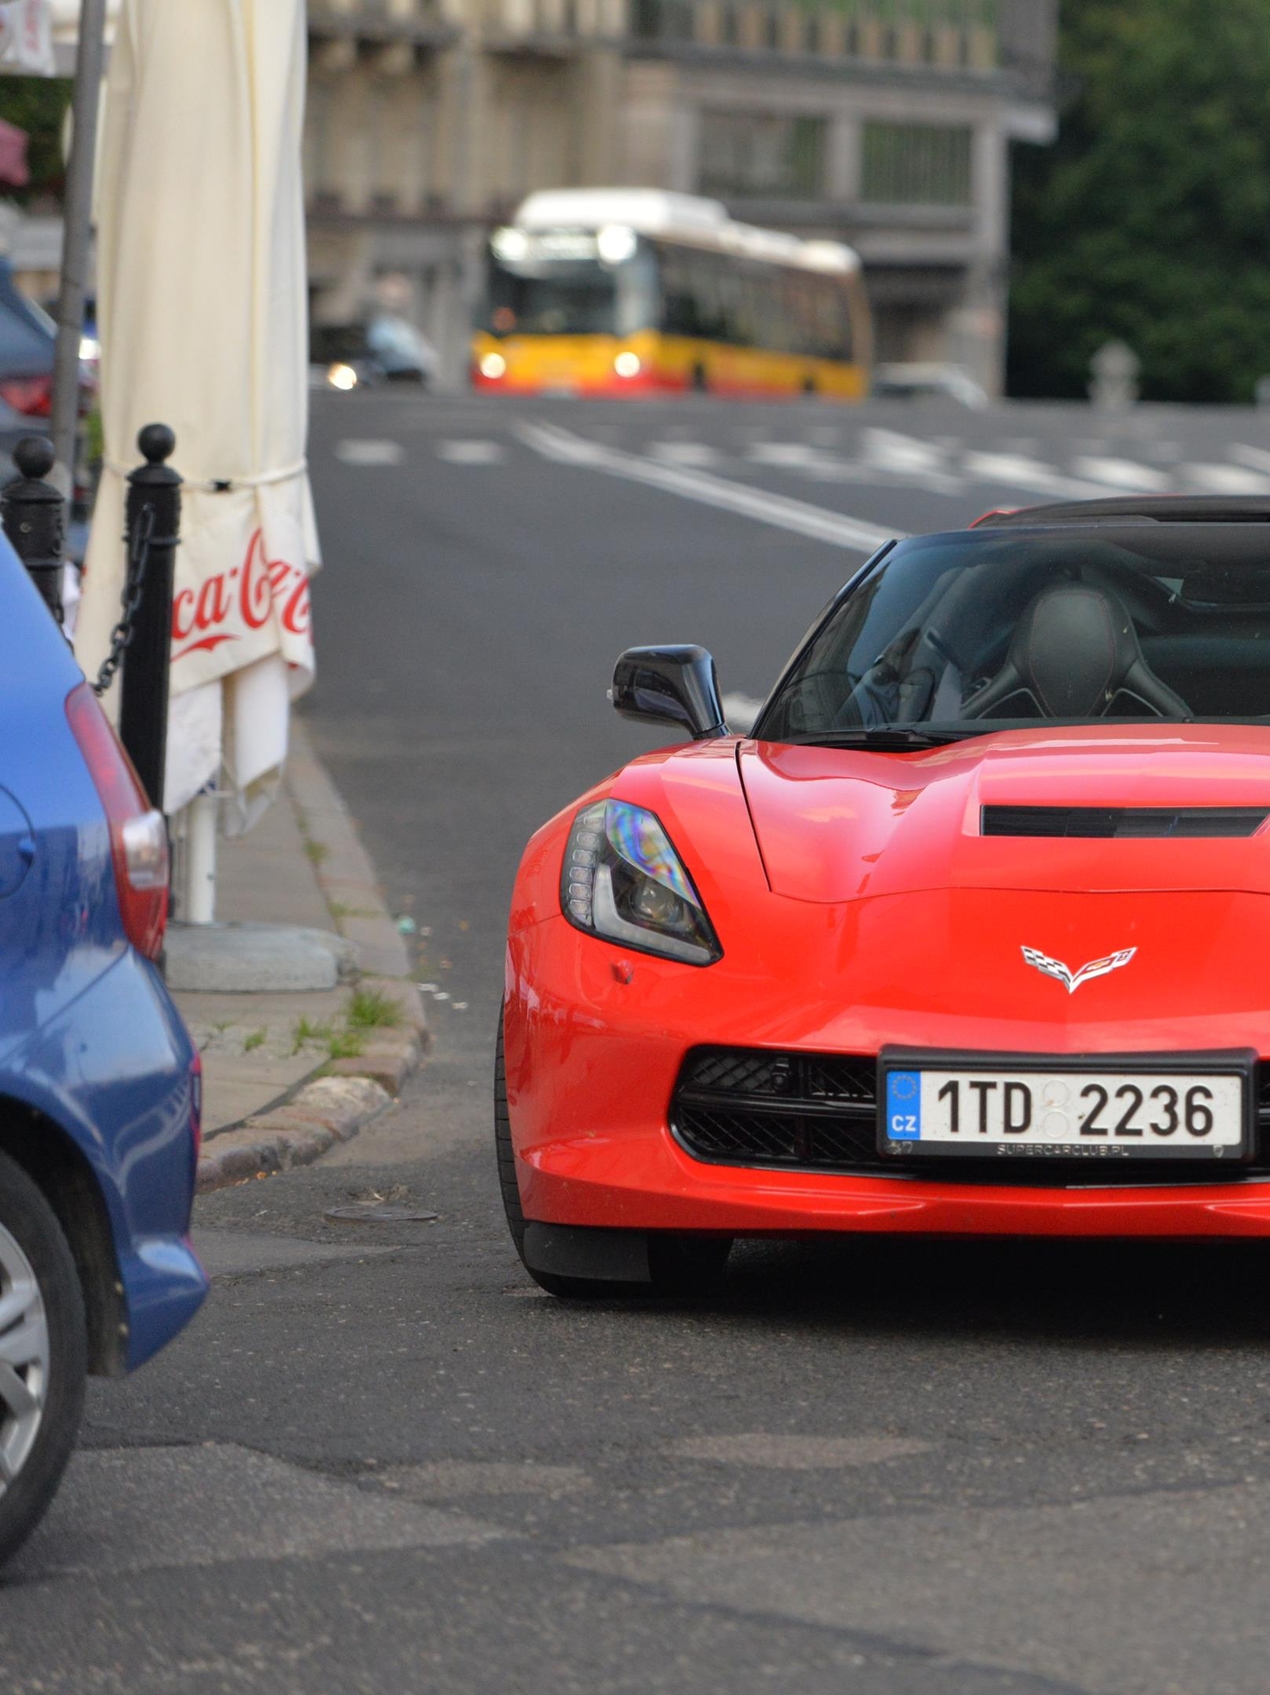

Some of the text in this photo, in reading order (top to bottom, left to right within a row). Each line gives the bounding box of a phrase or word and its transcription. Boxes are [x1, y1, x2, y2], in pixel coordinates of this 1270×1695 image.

[937, 1081, 1214, 1137] 1TD 2236
[891, 1115, 917, 1132] CZ
[996, 1143, 1129, 1157] SUPERCARCLUB.PL
